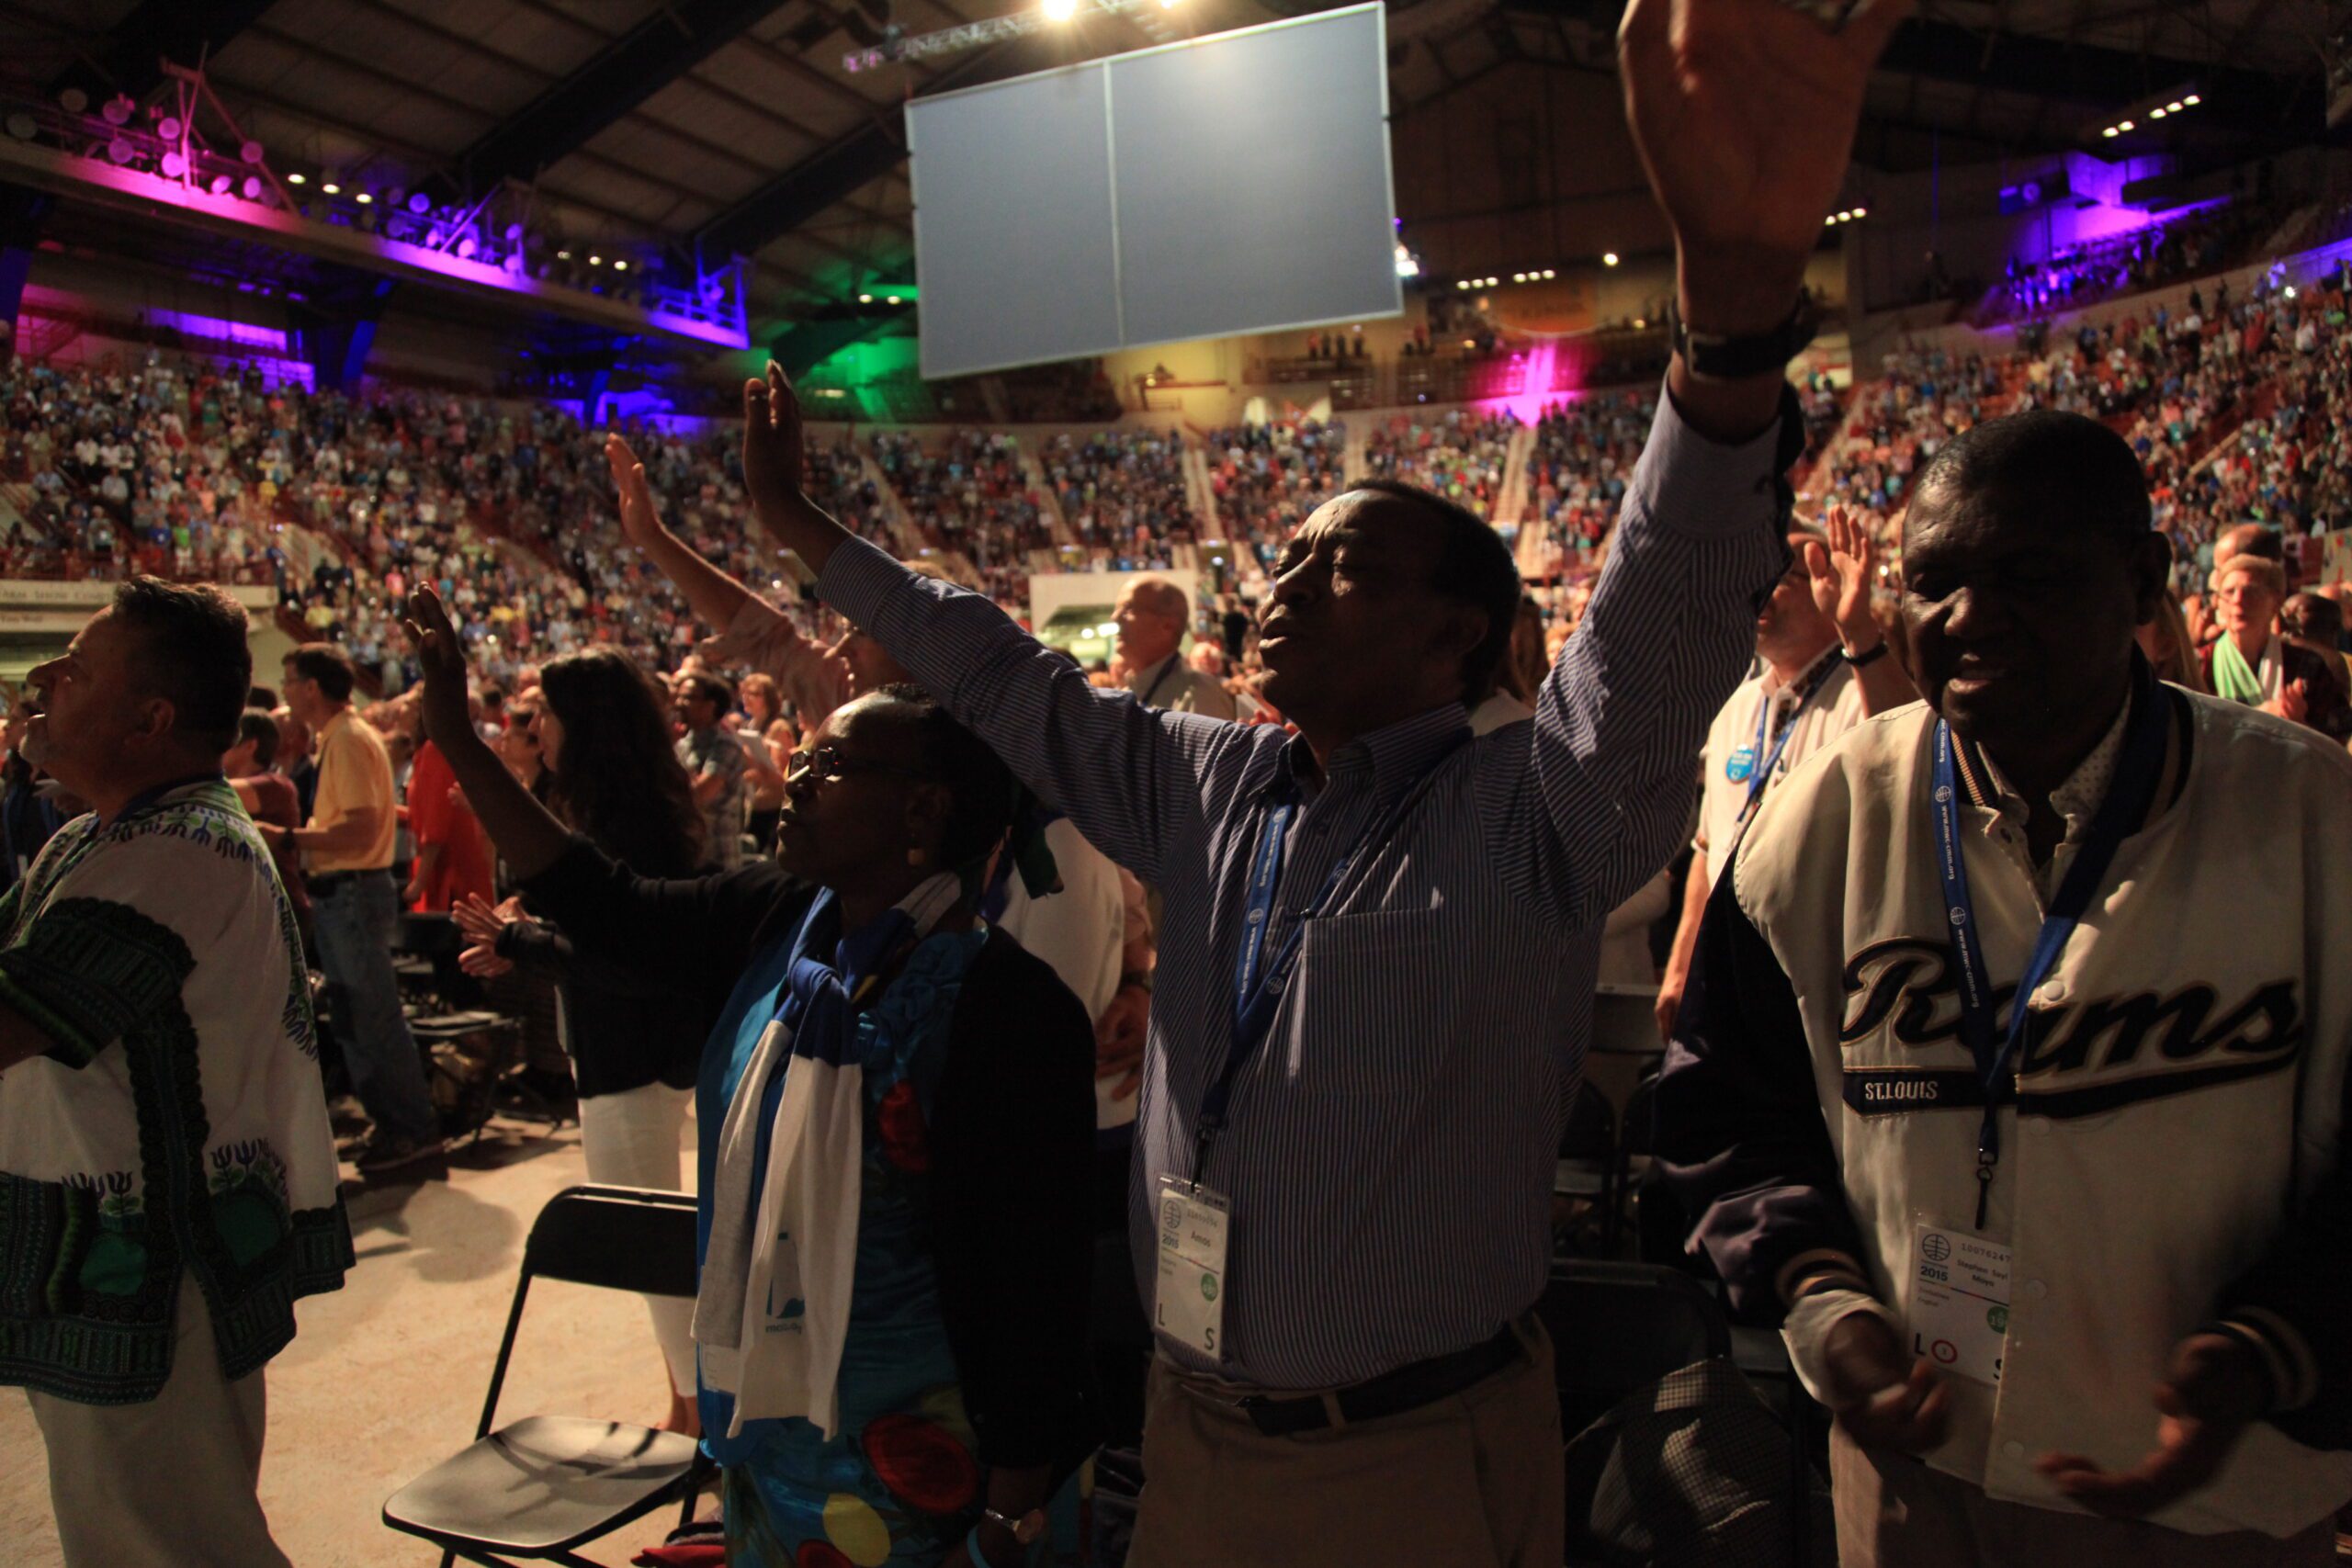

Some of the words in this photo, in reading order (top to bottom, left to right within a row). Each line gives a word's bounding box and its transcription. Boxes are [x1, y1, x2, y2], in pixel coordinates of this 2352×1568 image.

[1944, 805, 1955, 880] www.mwc-cmm.org
[1957, 929, 1981, 1007] www.mwc-cmm.org
[1840, 938, 2303, 1070] Rams
[1162, 1234, 1180, 1249] 2015
[1920, 1266, 1949, 1282] 2015
[1957, 1259, 1988, 1274] Stephen
[1158, 1303, 1165, 1326] L
[1204, 1327, 1215, 1350] S
[1915, 1333, 1926, 1356] L
